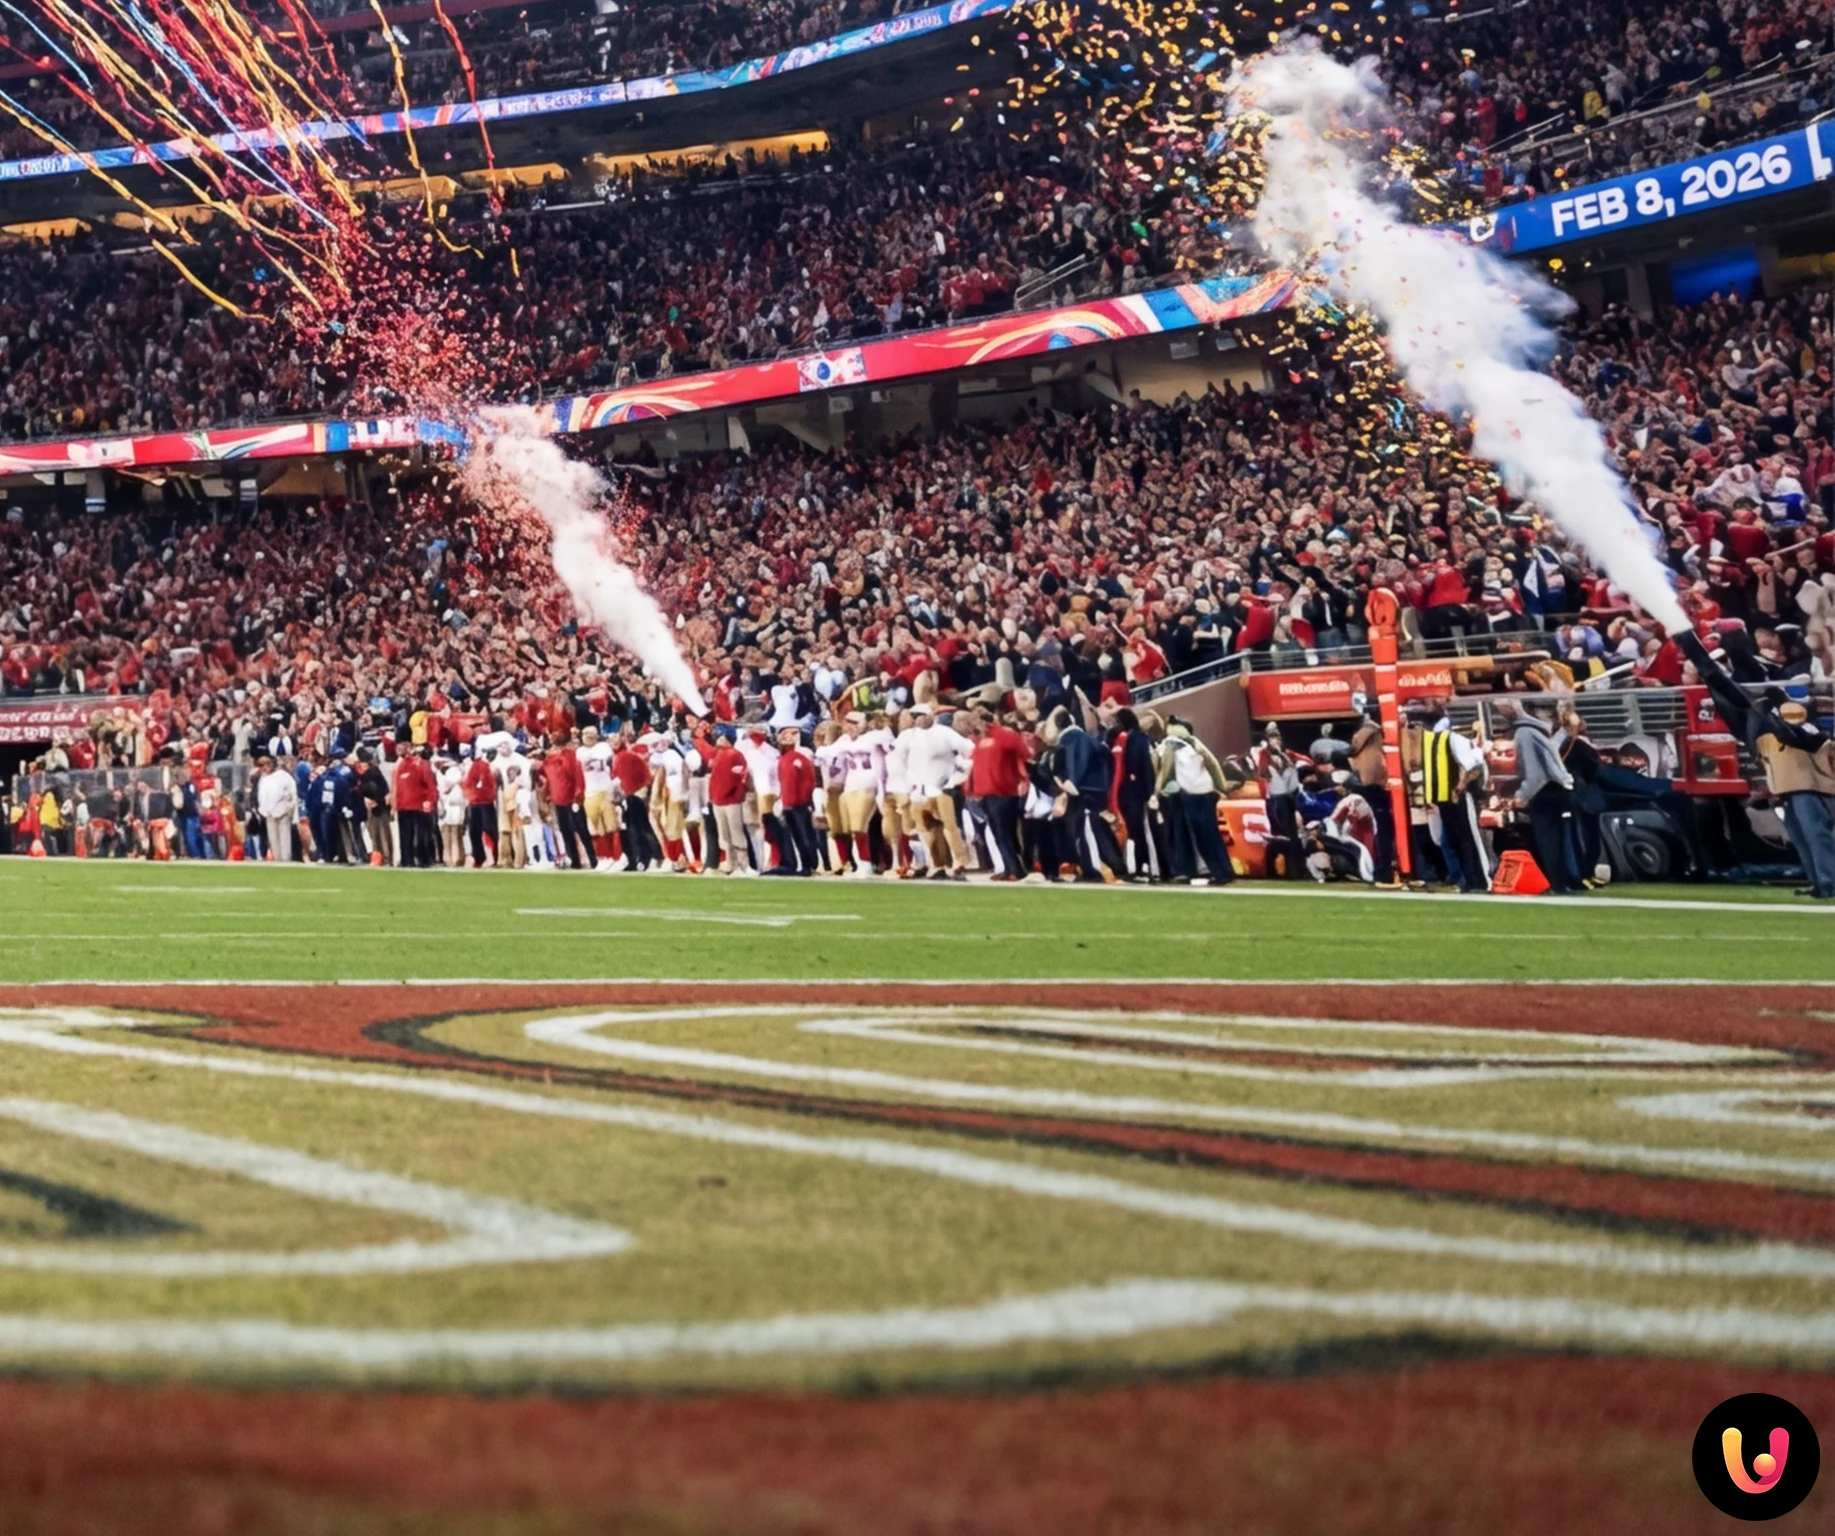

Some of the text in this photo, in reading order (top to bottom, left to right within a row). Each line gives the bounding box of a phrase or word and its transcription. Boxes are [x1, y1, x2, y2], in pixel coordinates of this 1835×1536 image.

[1551, 144, 1792, 237] FEB 8, 2026
